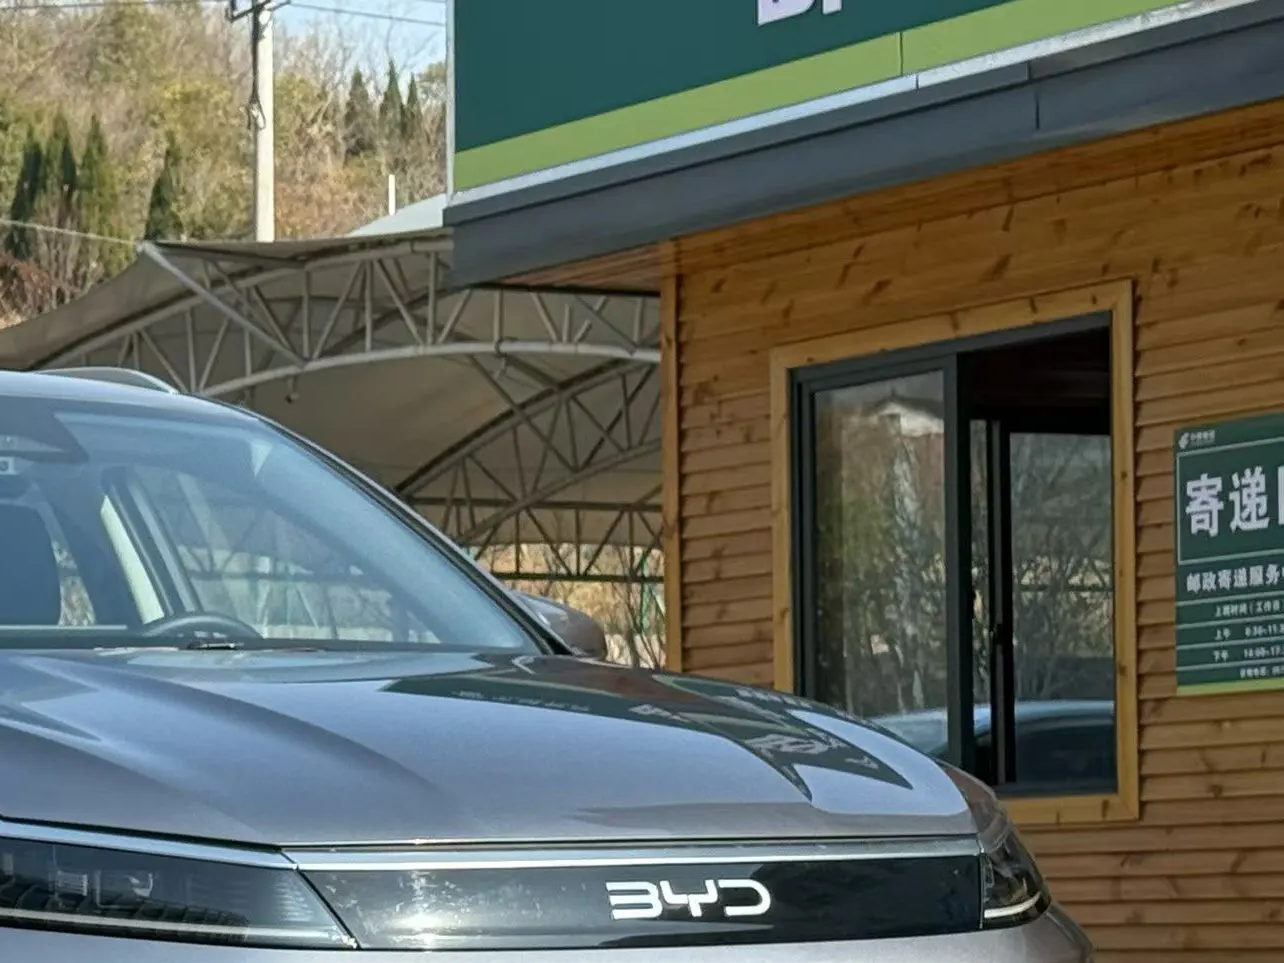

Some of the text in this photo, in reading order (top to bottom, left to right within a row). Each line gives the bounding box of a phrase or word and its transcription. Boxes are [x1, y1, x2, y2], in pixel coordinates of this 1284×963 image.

[1186, 465, 1284, 537] 寄递
[1187, 563, 1284, 594] 邮政寄递服务
[605, 878, 772, 921] BYD
